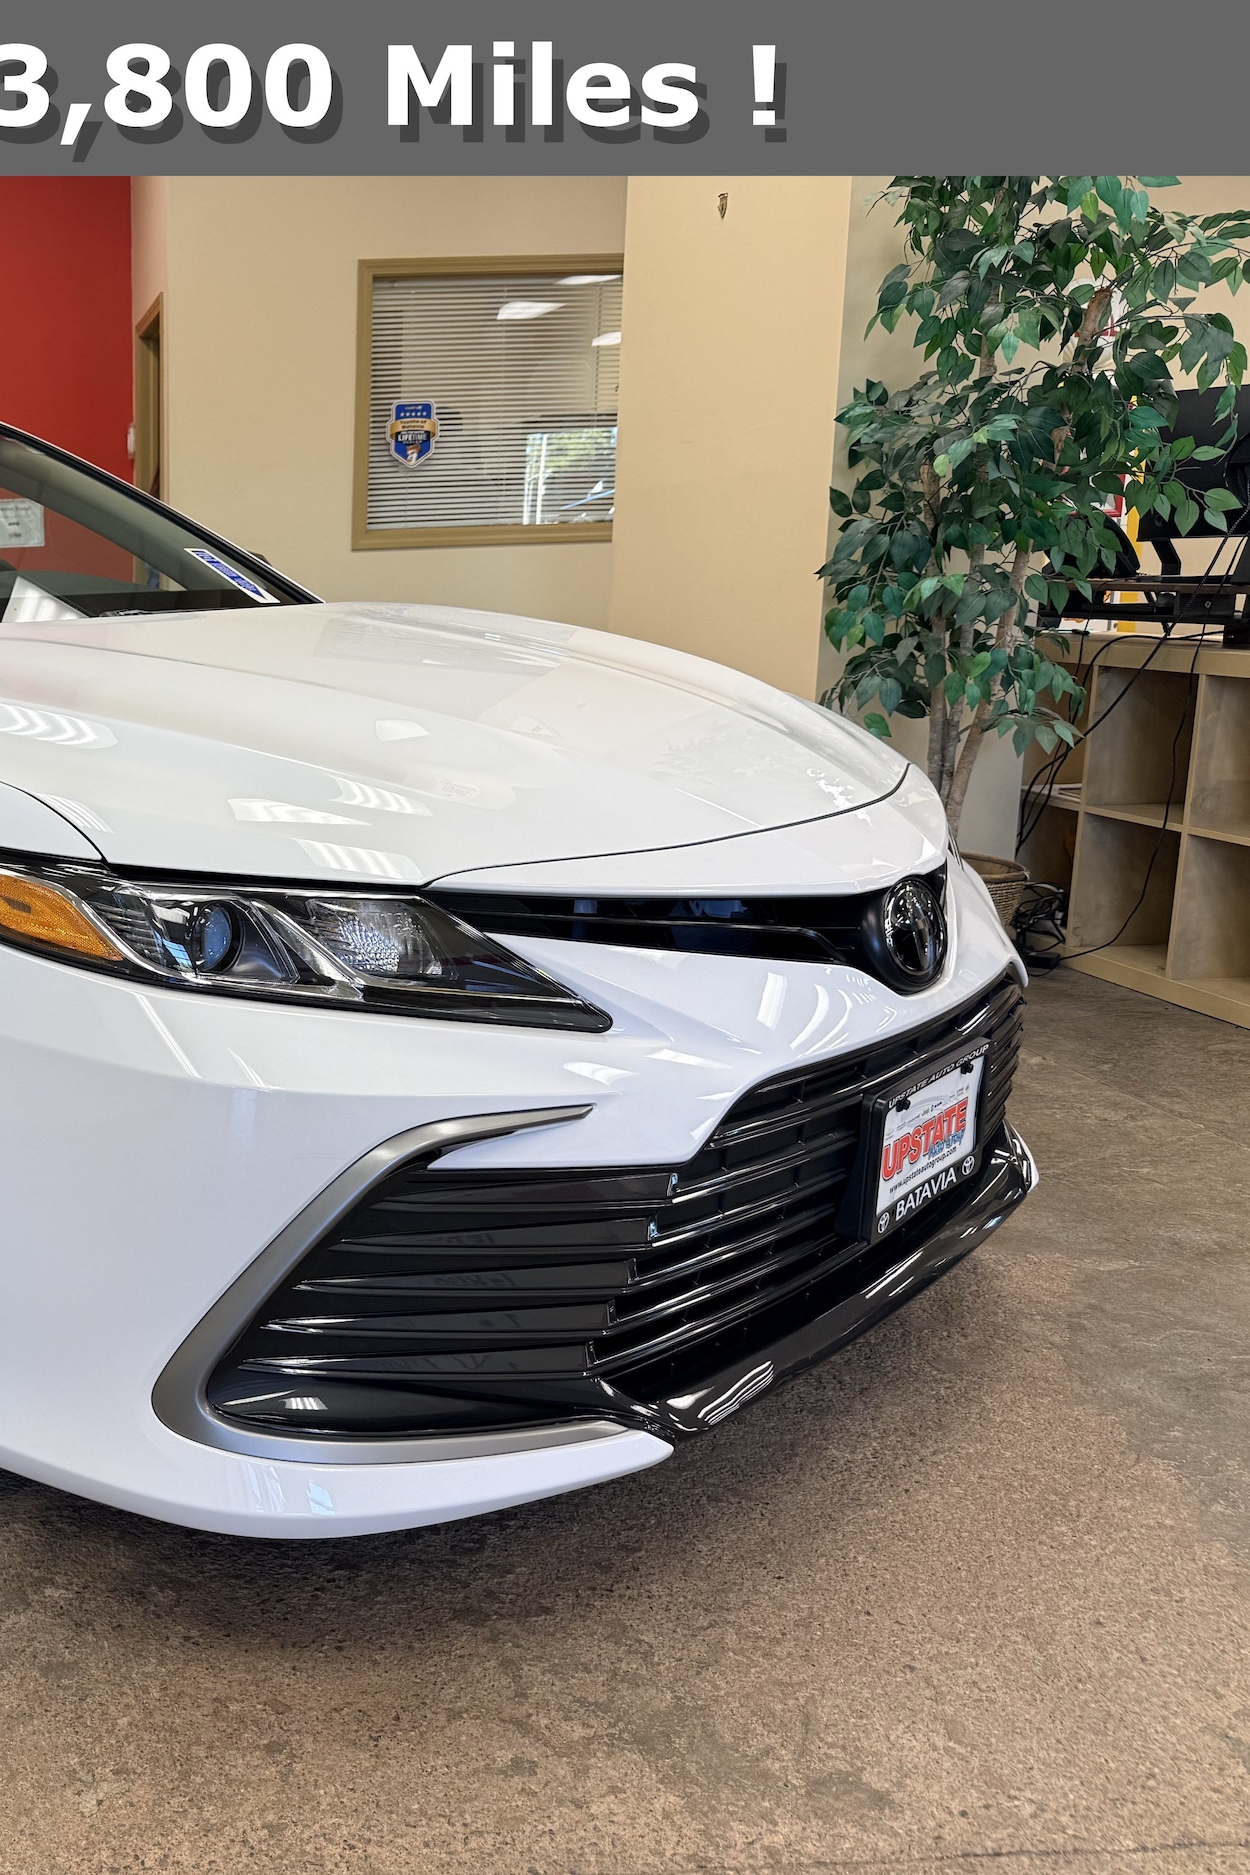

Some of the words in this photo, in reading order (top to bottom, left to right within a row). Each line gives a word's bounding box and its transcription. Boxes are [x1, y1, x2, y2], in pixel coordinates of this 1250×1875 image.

[928, 1063, 955, 1083] AUTO
[956, 1044, 990, 1067] GROUP
[882, 1096, 969, 1181] UPSTATE
[889, 1146, 957, 1194] www.upstateautogroup.com
[895, 1166, 957, 1222] BATAVIA
